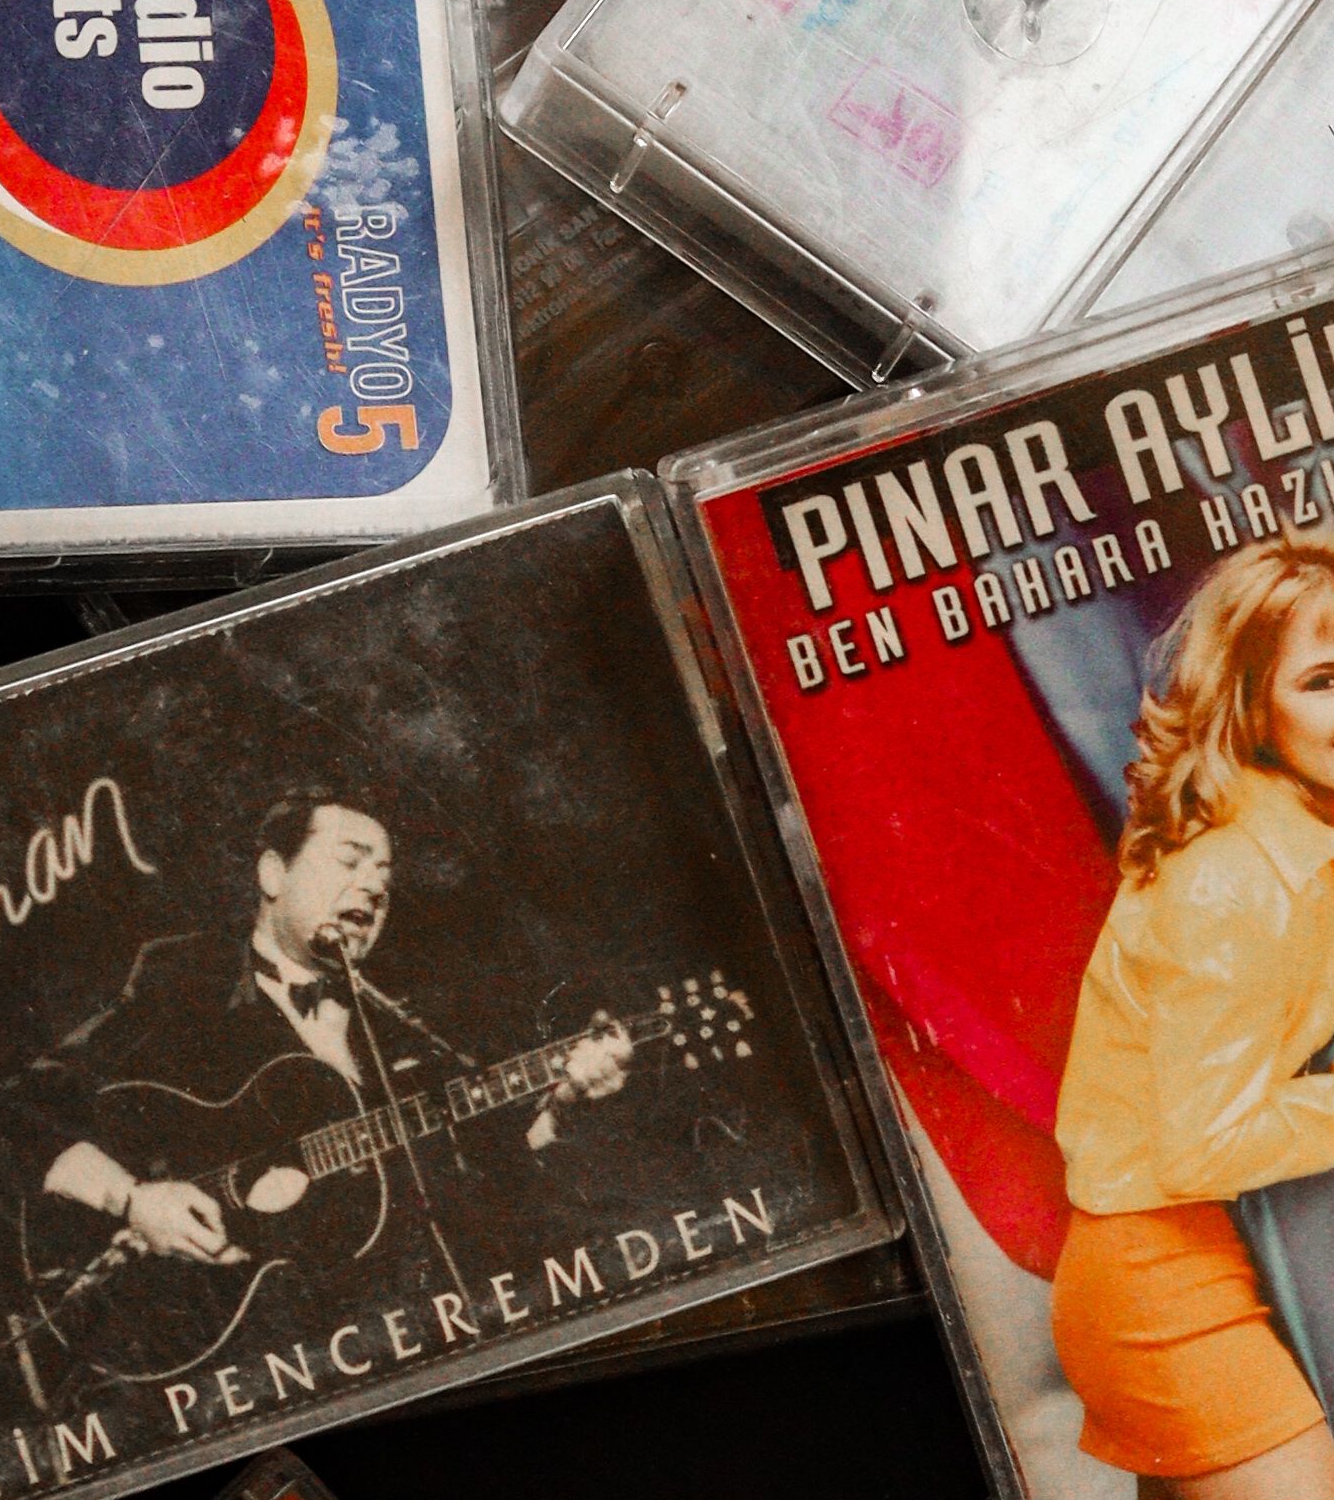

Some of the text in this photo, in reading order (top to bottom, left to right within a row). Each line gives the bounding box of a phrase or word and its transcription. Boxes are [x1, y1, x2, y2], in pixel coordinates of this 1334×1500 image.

[779, 415, 1101, 613] PINAR
[787, 625, 904, 695] BEN
[930, 515, 1176, 643] BAHARA
[164, 1187, 780, 1435] PENCEREMDEN
